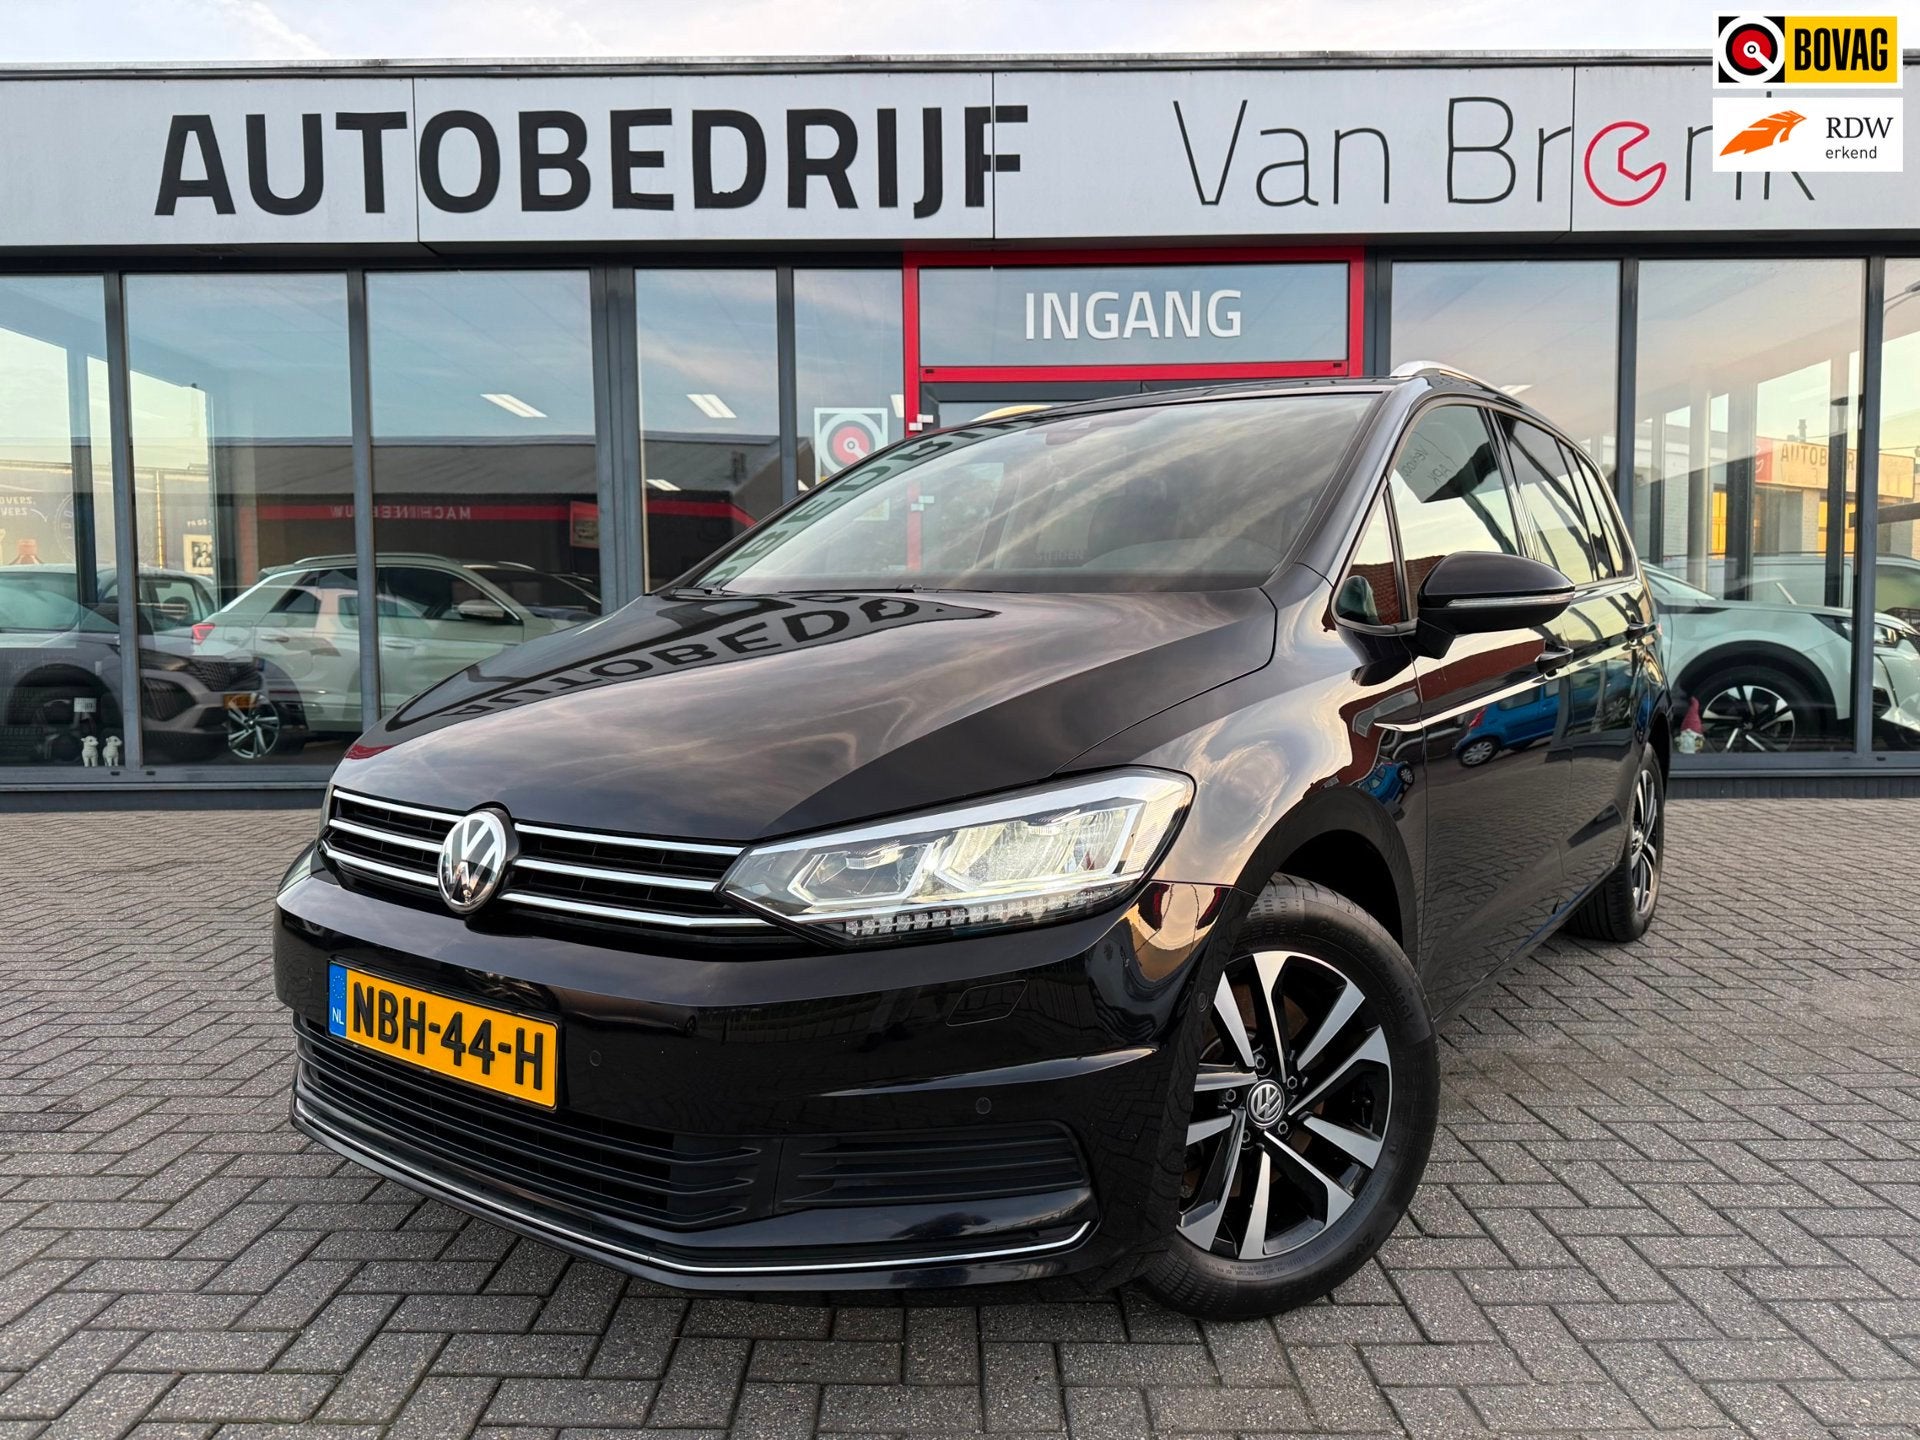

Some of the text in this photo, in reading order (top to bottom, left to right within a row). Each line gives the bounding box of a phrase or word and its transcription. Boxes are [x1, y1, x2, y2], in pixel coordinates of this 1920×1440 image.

[154, 104, 1029, 219] AUTOBEDRIJF
[1173, 99, 1391, 207] Van
[1025, 289, 1242, 340] INGANG
[332, 1007, 344, 1025] NL
[353, 981, 543, 1091] NBH-44-H
